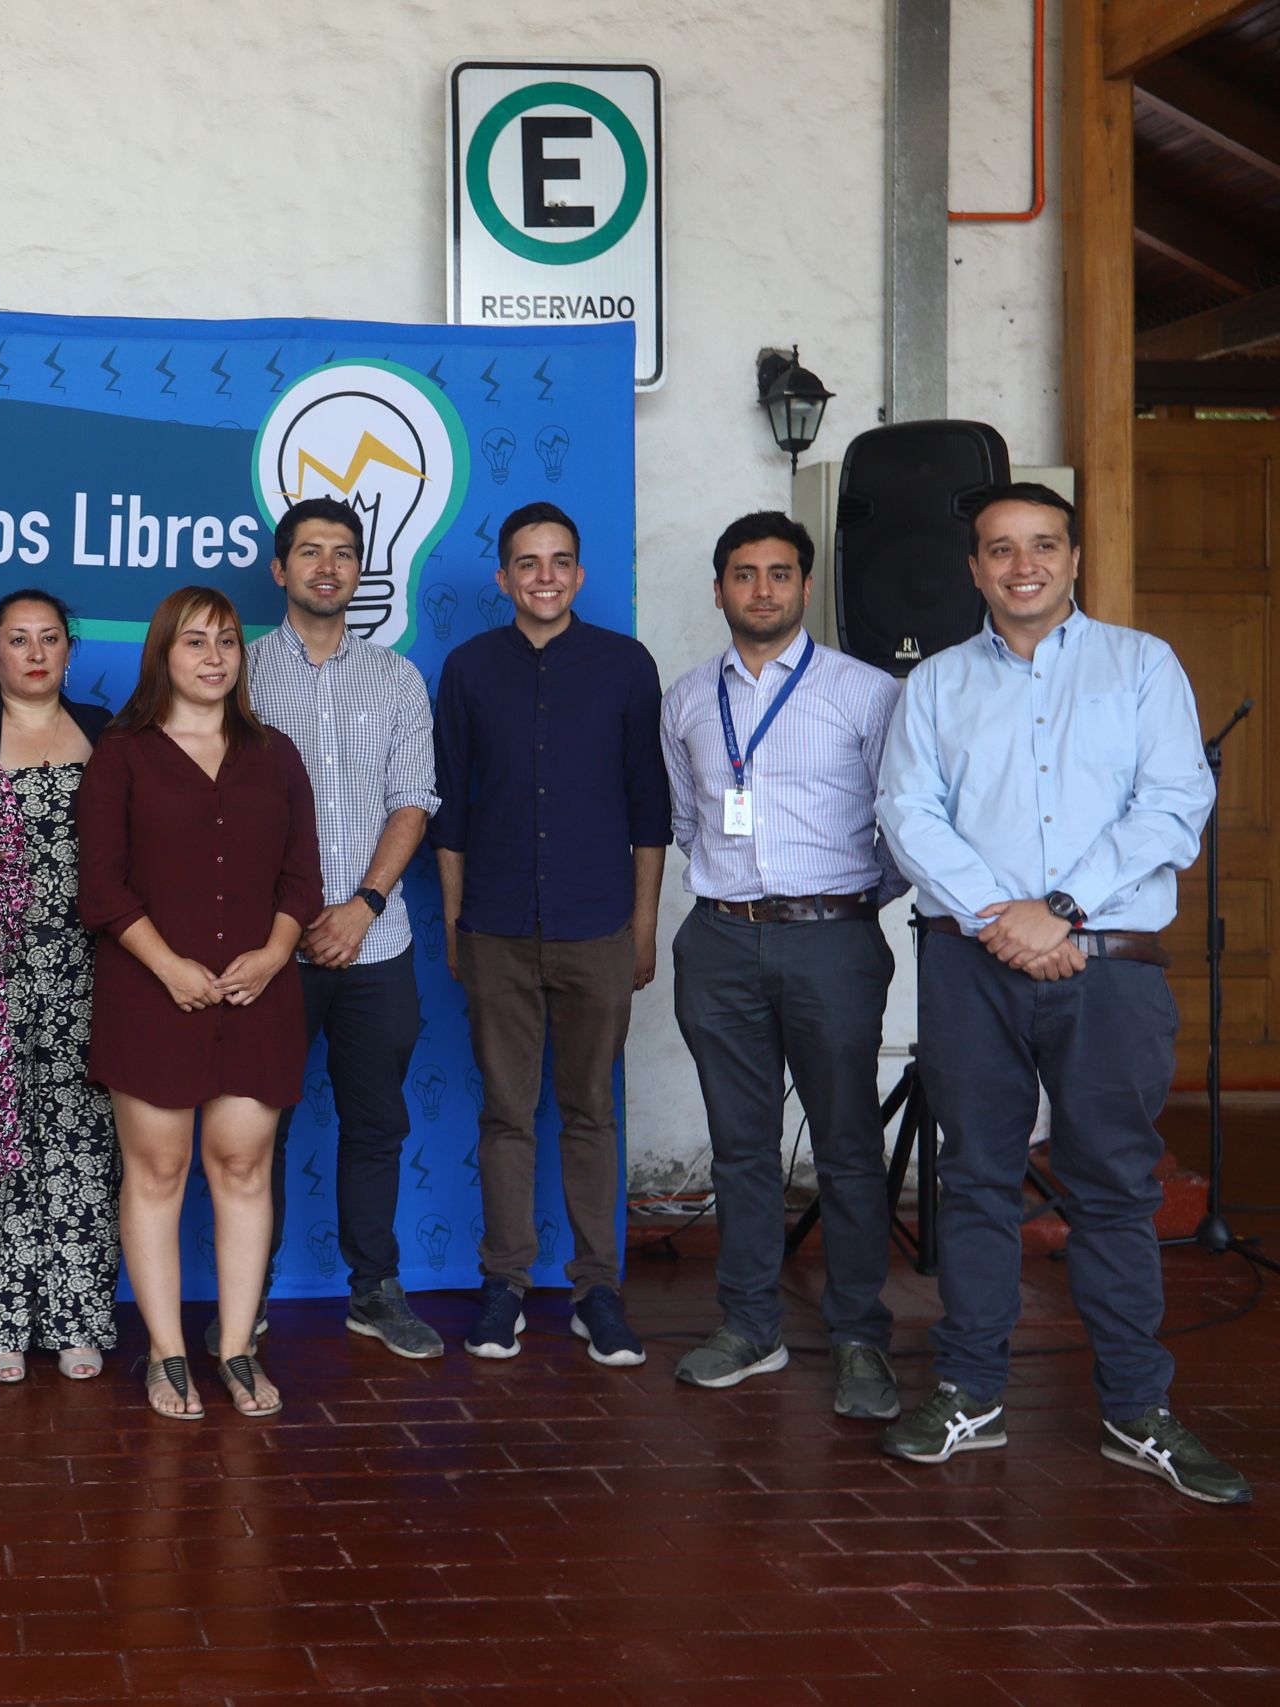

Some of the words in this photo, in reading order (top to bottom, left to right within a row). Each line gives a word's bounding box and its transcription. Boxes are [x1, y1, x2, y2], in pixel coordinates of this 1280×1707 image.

[520, 116, 595, 229] E
[481, 295, 635, 319] RESERVADO
[73, 491, 259, 568] Libres
